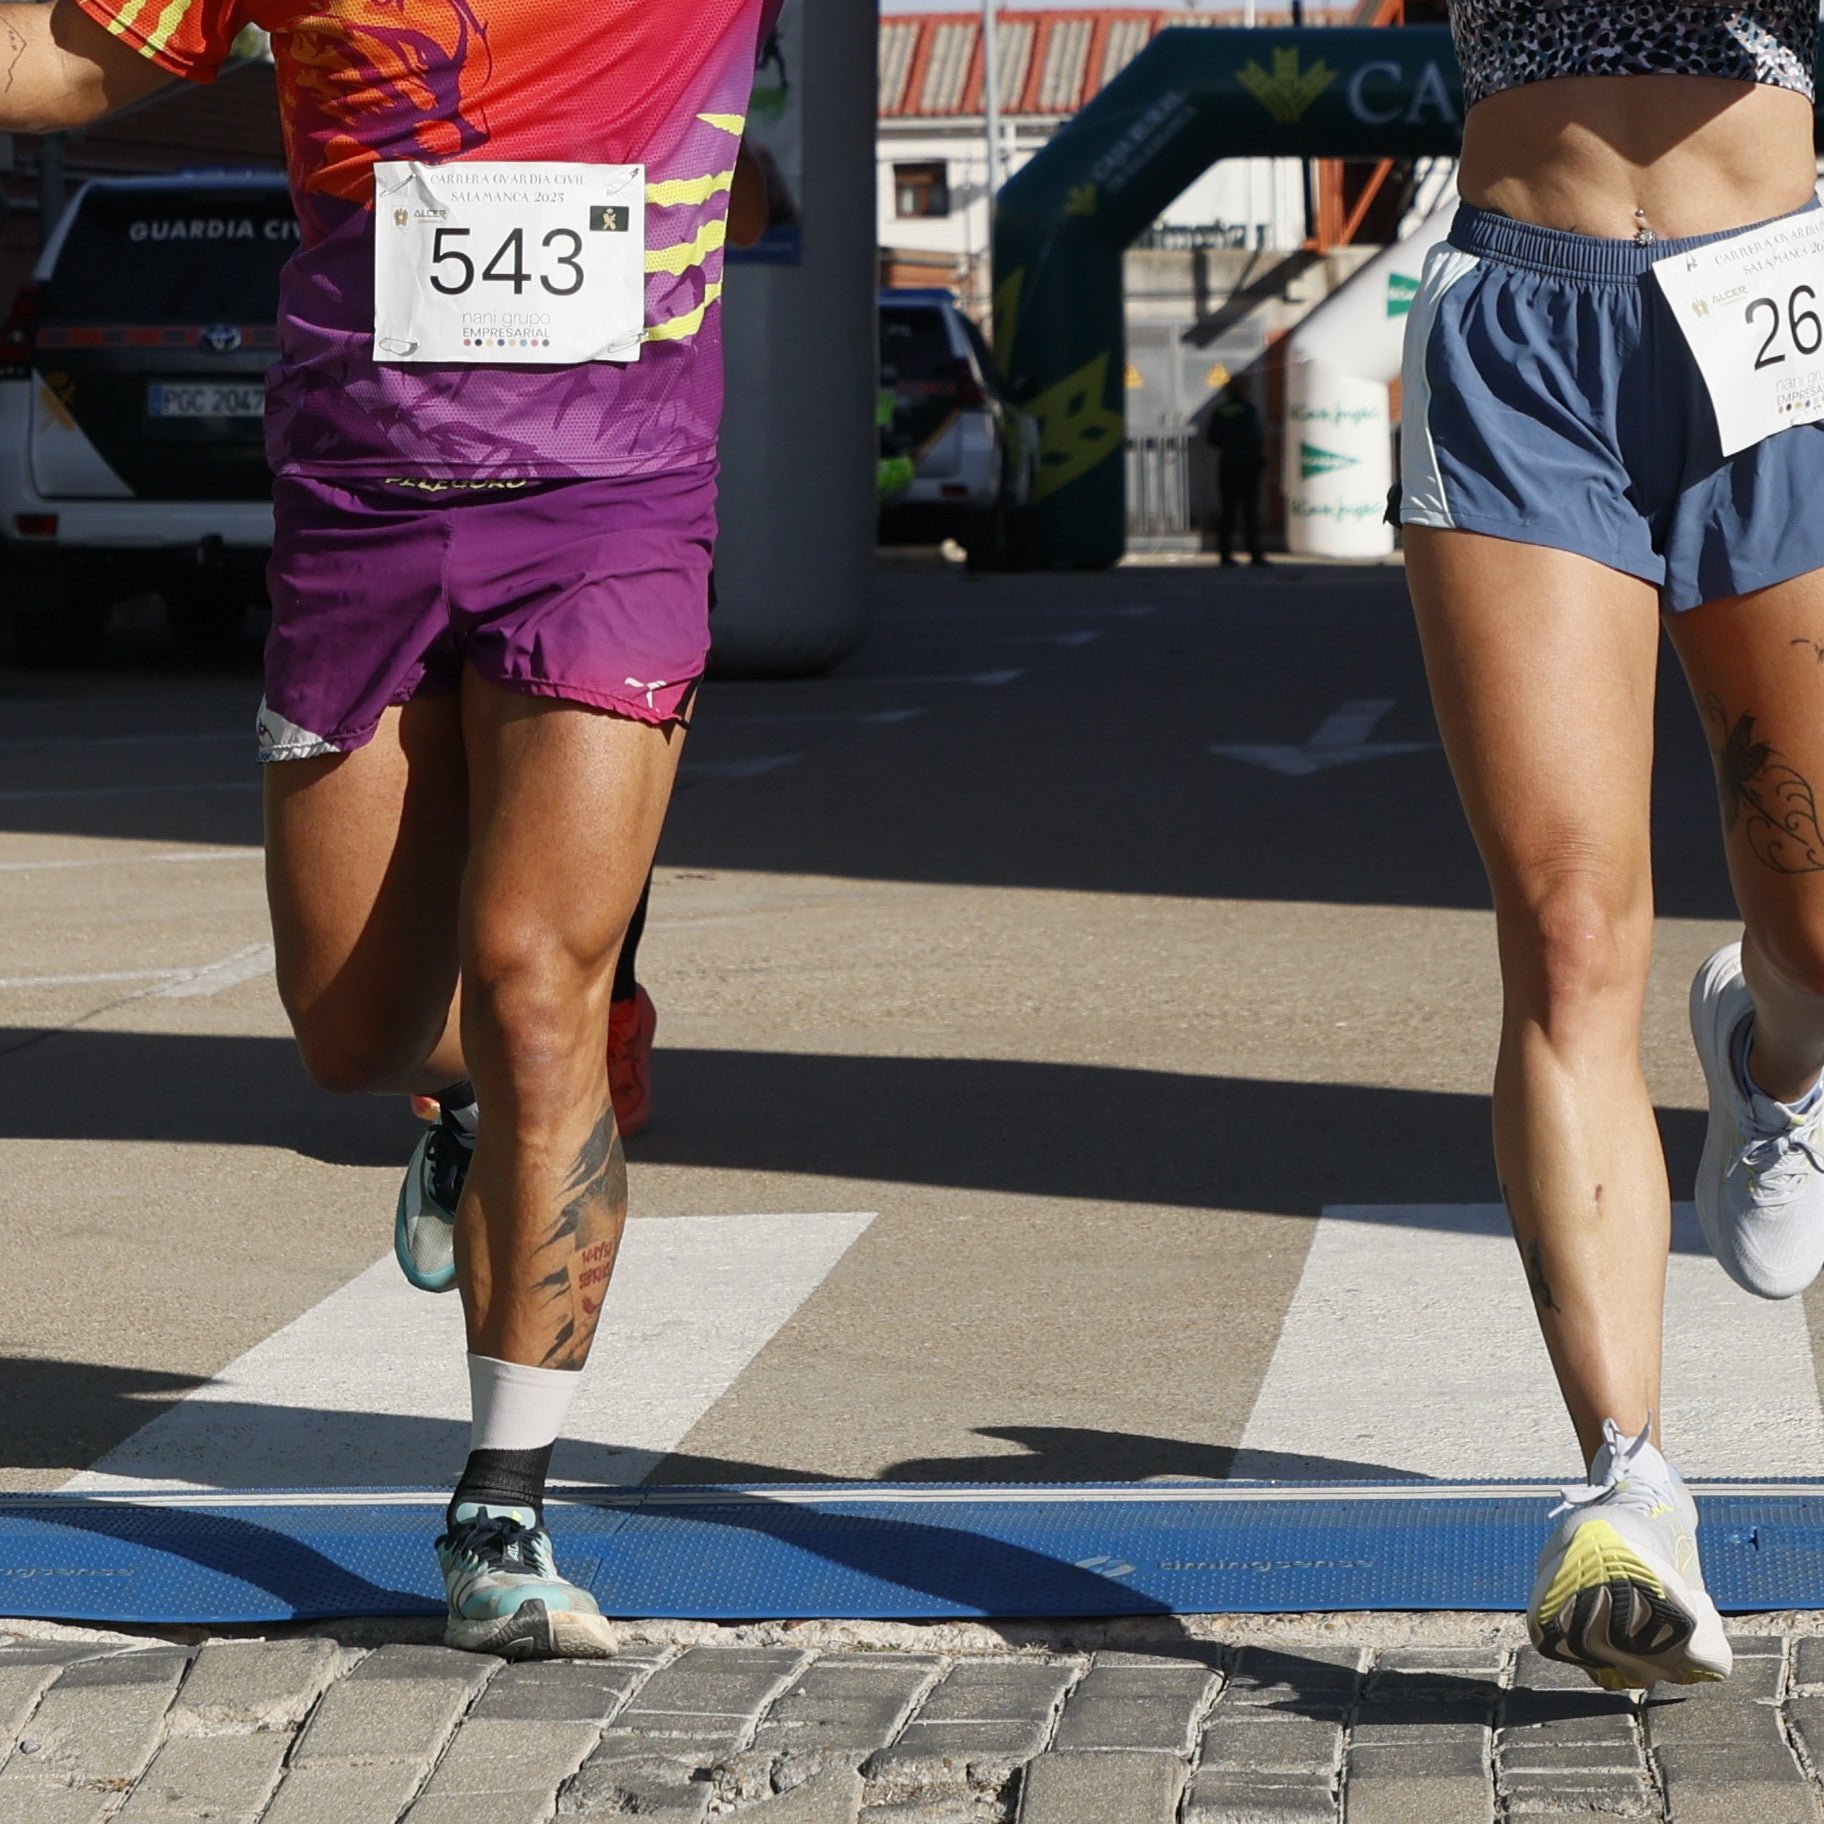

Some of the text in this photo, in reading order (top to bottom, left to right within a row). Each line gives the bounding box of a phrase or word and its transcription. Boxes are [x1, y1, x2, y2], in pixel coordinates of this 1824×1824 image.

[1345, 58, 1464, 127] CA
[430, 173, 489, 186] CARRERA
[554, 174, 586, 186] CIVIL
[450, 190, 566, 204] SALAMANCA 2025
[128, 218, 301, 243] GUARDIA CIV
[1714, 238, 1774, 267] CARRERA
[429, 227, 585, 297] 543
[462, 311, 552, 328] nani grupo
[462, 327, 551, 339] EMPRESARIAL
[1776, 375, 1805, 393] nani
